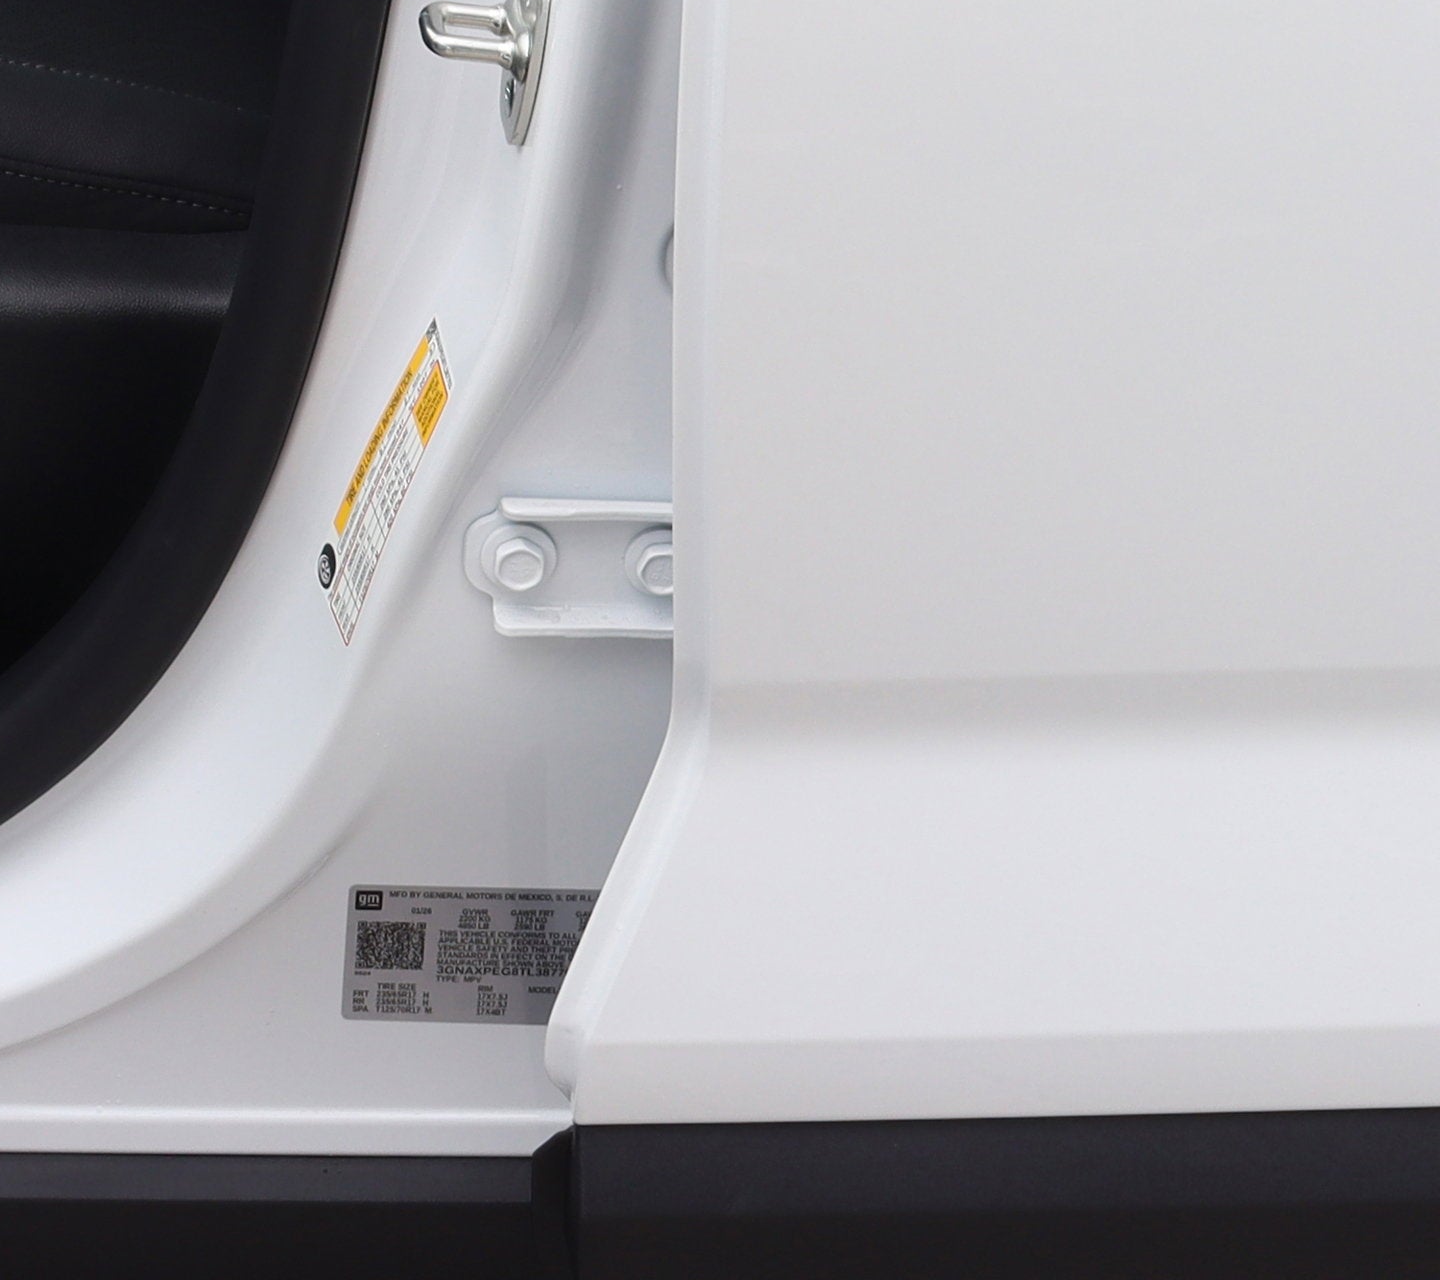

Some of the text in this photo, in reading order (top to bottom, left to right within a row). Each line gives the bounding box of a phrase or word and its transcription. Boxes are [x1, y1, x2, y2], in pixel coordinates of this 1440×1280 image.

[364, 426, 384, 469] LOADING
[382, 368, 414, 431] INFORMATION
[359, 894, 380, 907] gm
[518, 894, 554, 902] MEXICO,
[529, 946, 556, 954] THEFT
